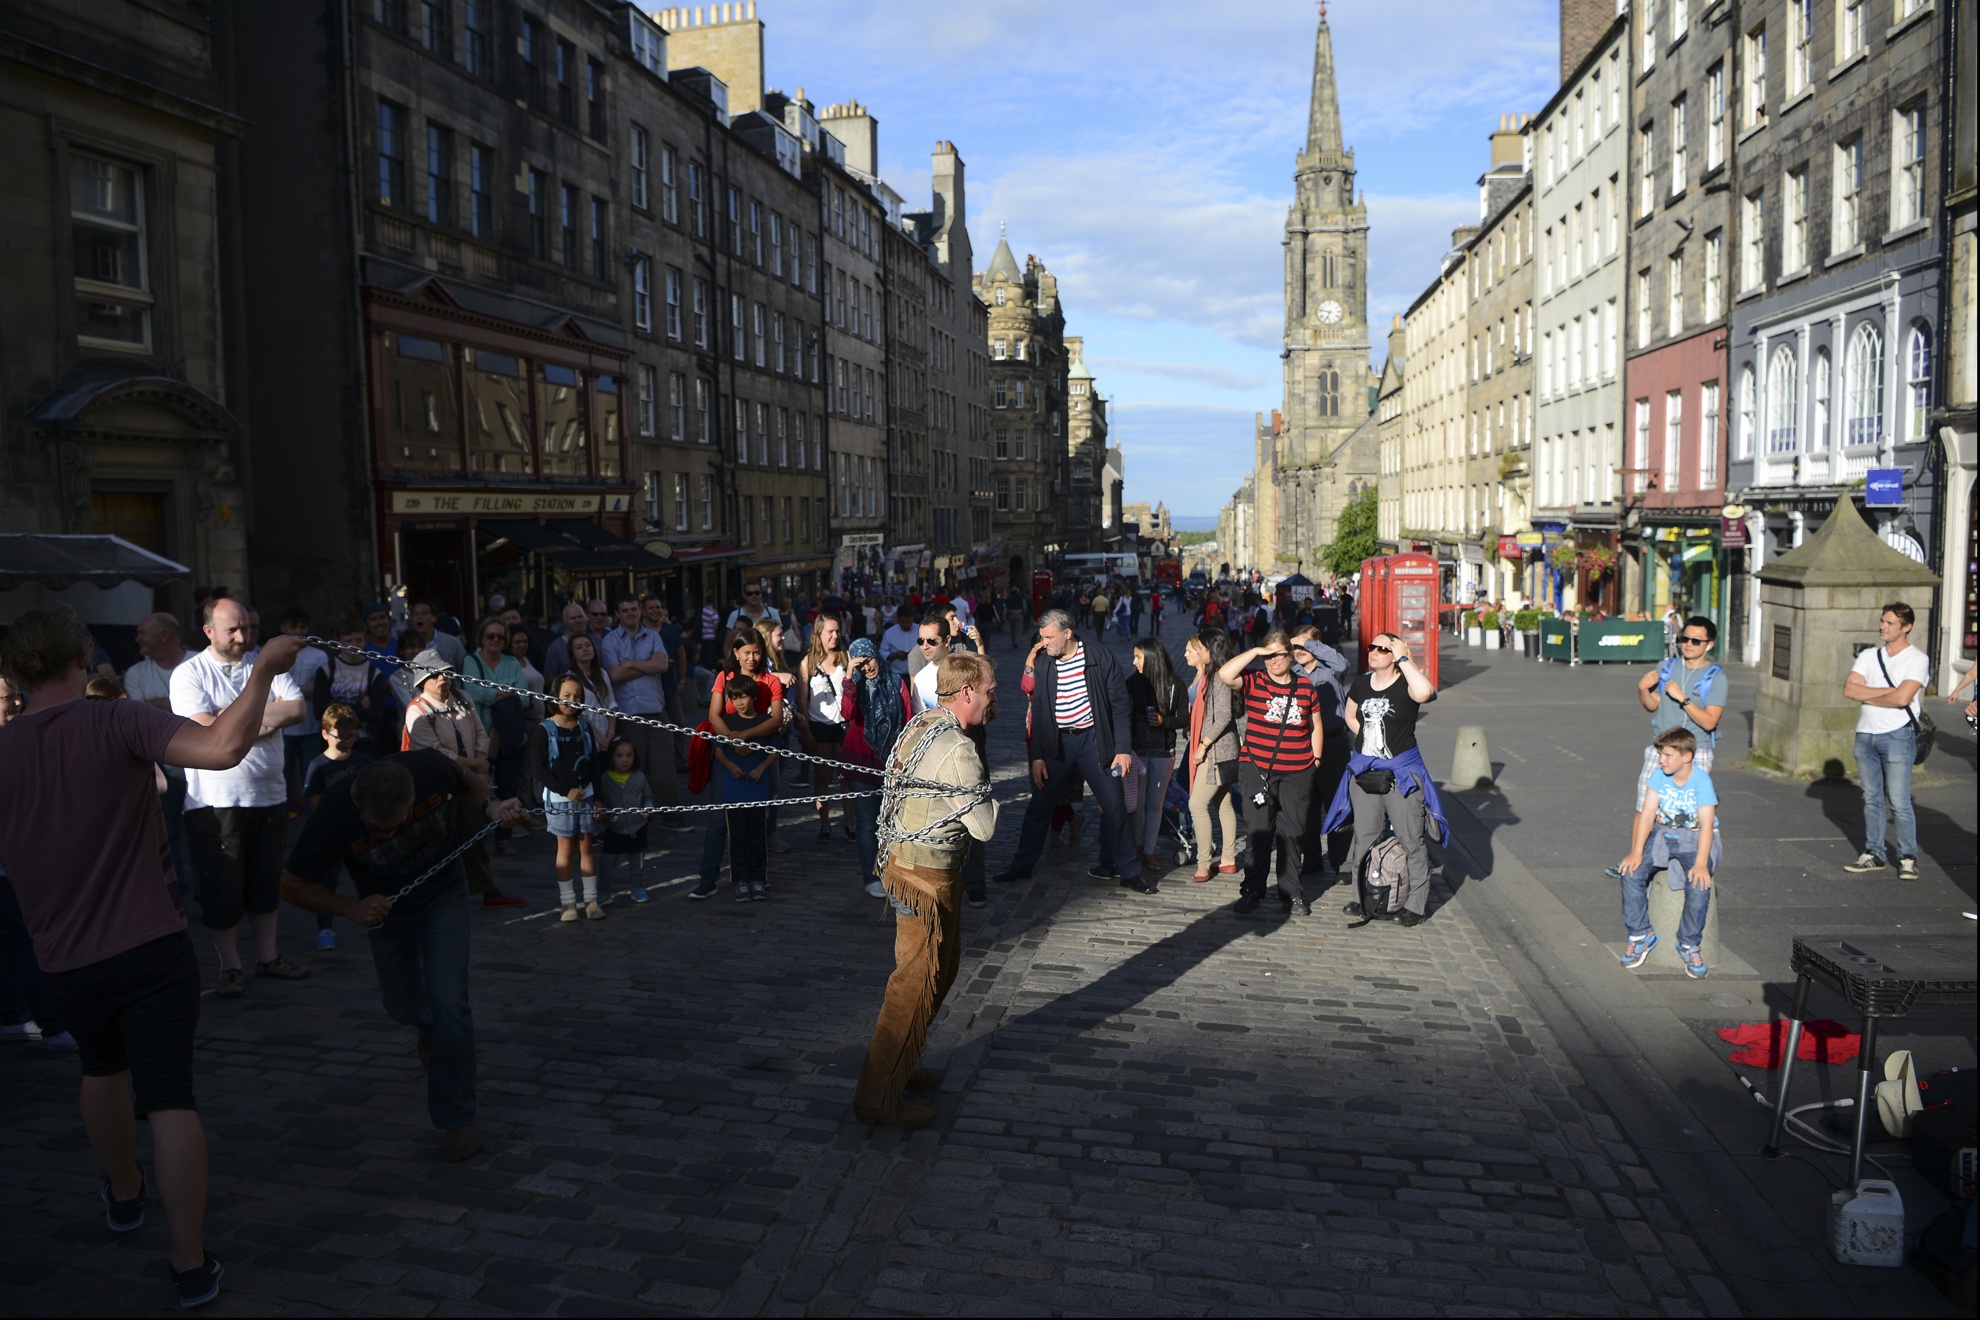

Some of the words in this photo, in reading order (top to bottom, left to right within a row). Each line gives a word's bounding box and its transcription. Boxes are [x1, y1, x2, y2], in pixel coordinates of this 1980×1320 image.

[433, 497, 461, 510] THE
[473, 498, 523, 510] FILLING
[533, 498, 576, 510] STATION
[1598, 633, 1645, 647] SUBWAY
